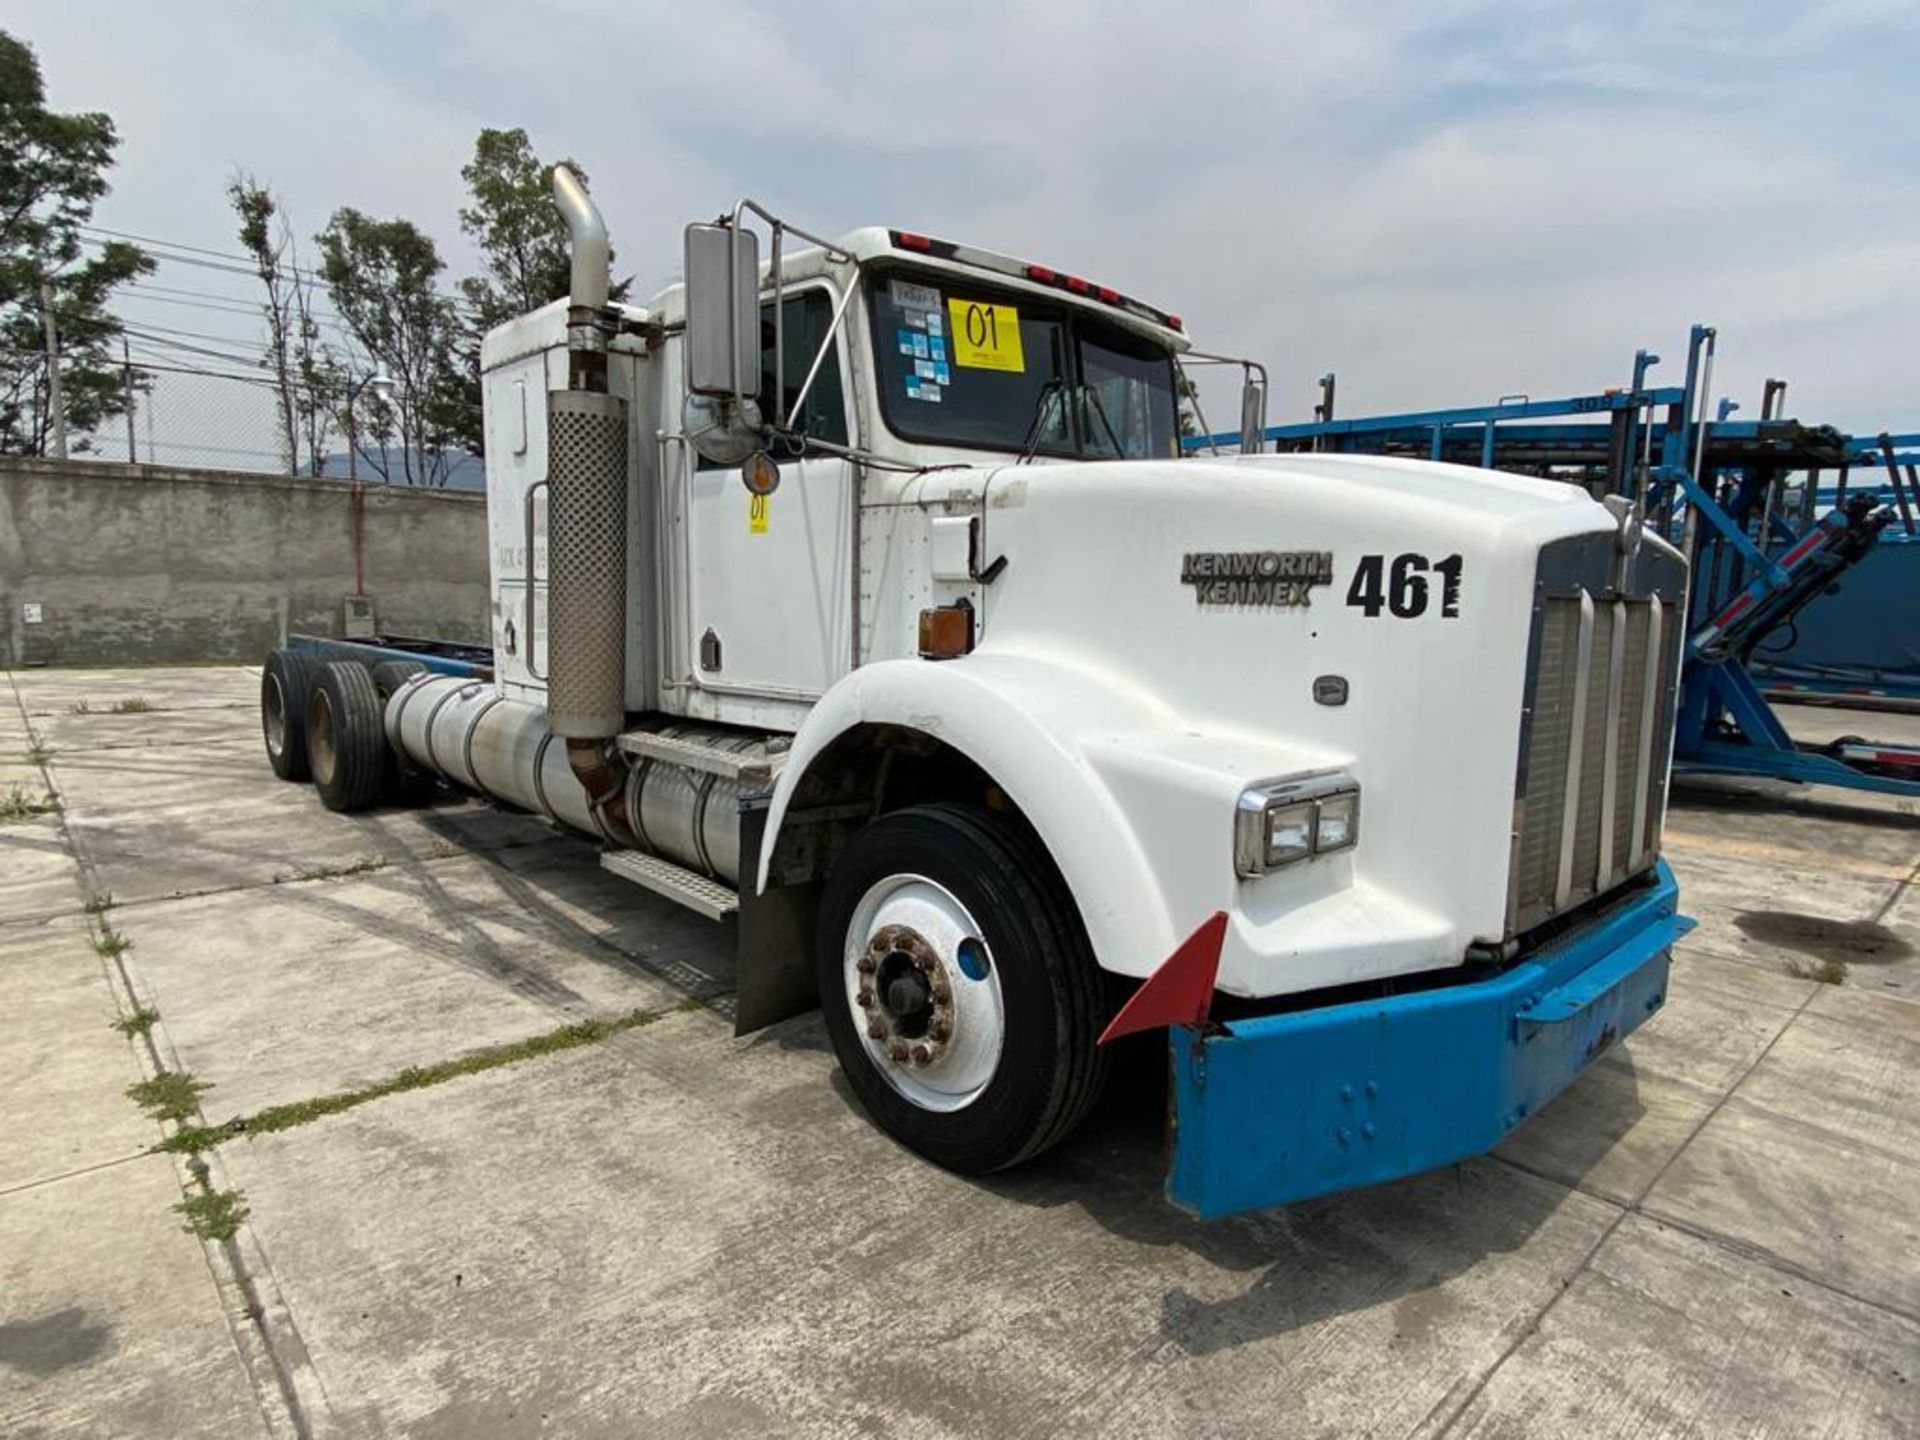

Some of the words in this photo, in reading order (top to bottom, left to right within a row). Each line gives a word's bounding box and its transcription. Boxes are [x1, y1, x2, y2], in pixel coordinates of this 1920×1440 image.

[966, 303, 998, 351] 01
[751, 493, 765, 521] 01
[1182, 552, 1333, 577] KENWORTH
[1196, 580, 1312, 607] KENMEX
[1346, 553, 1462, 618] 461
